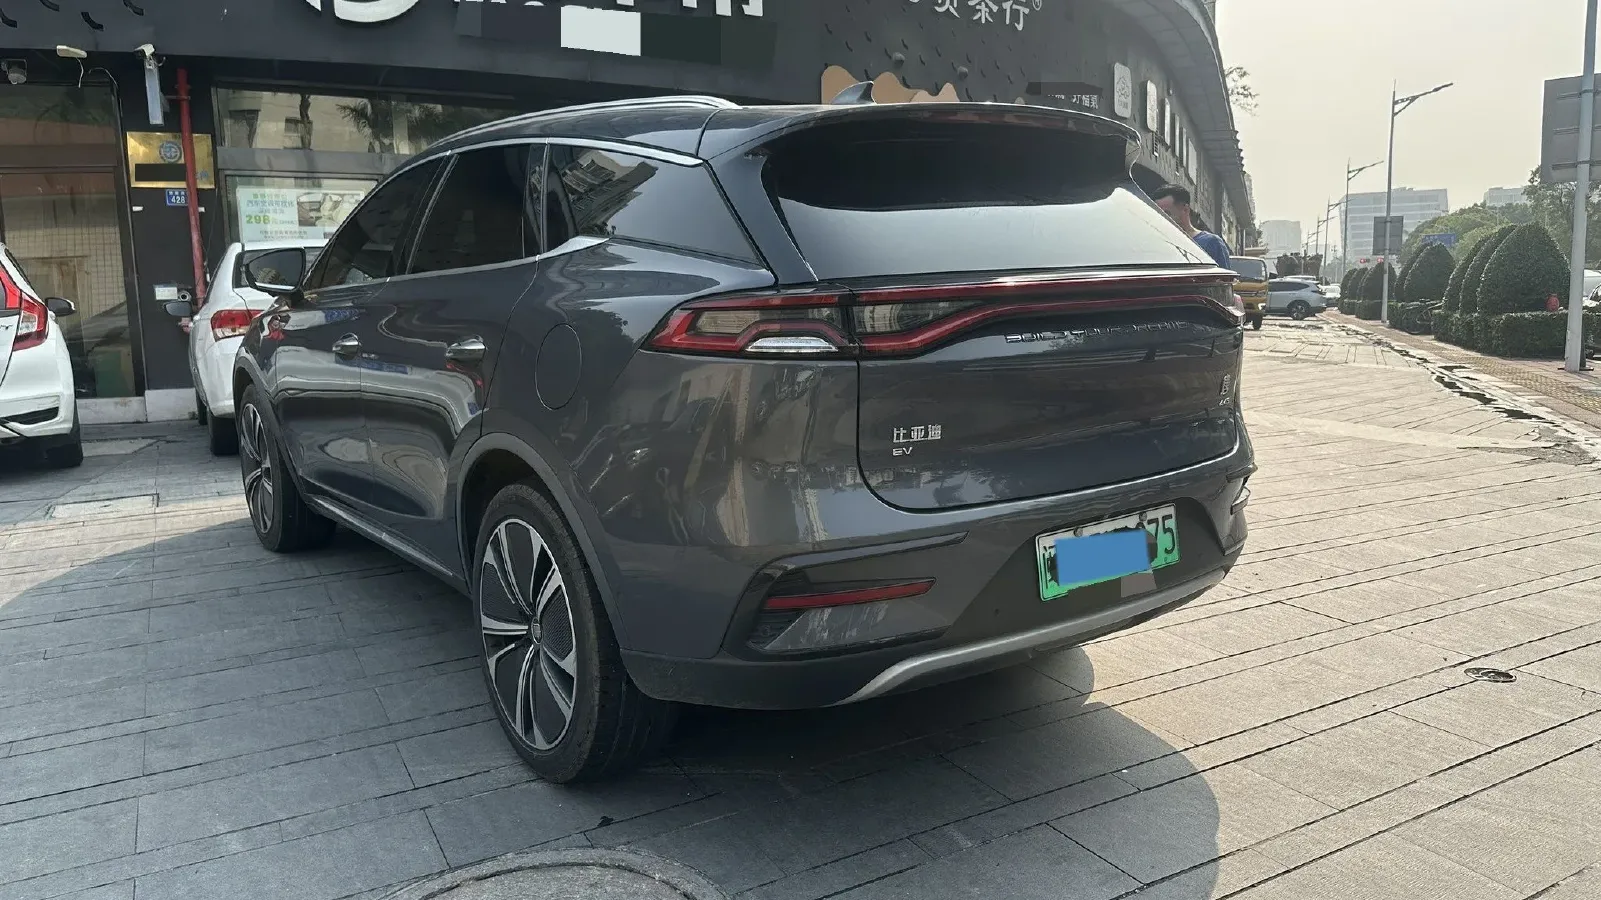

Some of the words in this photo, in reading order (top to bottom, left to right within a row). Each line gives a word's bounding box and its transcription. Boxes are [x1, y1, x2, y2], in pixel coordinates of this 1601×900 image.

[171, 195, 186, 204] 428
[892, 424, 942, 443] 比亚迪
[892, 446, 913, 456] EV
